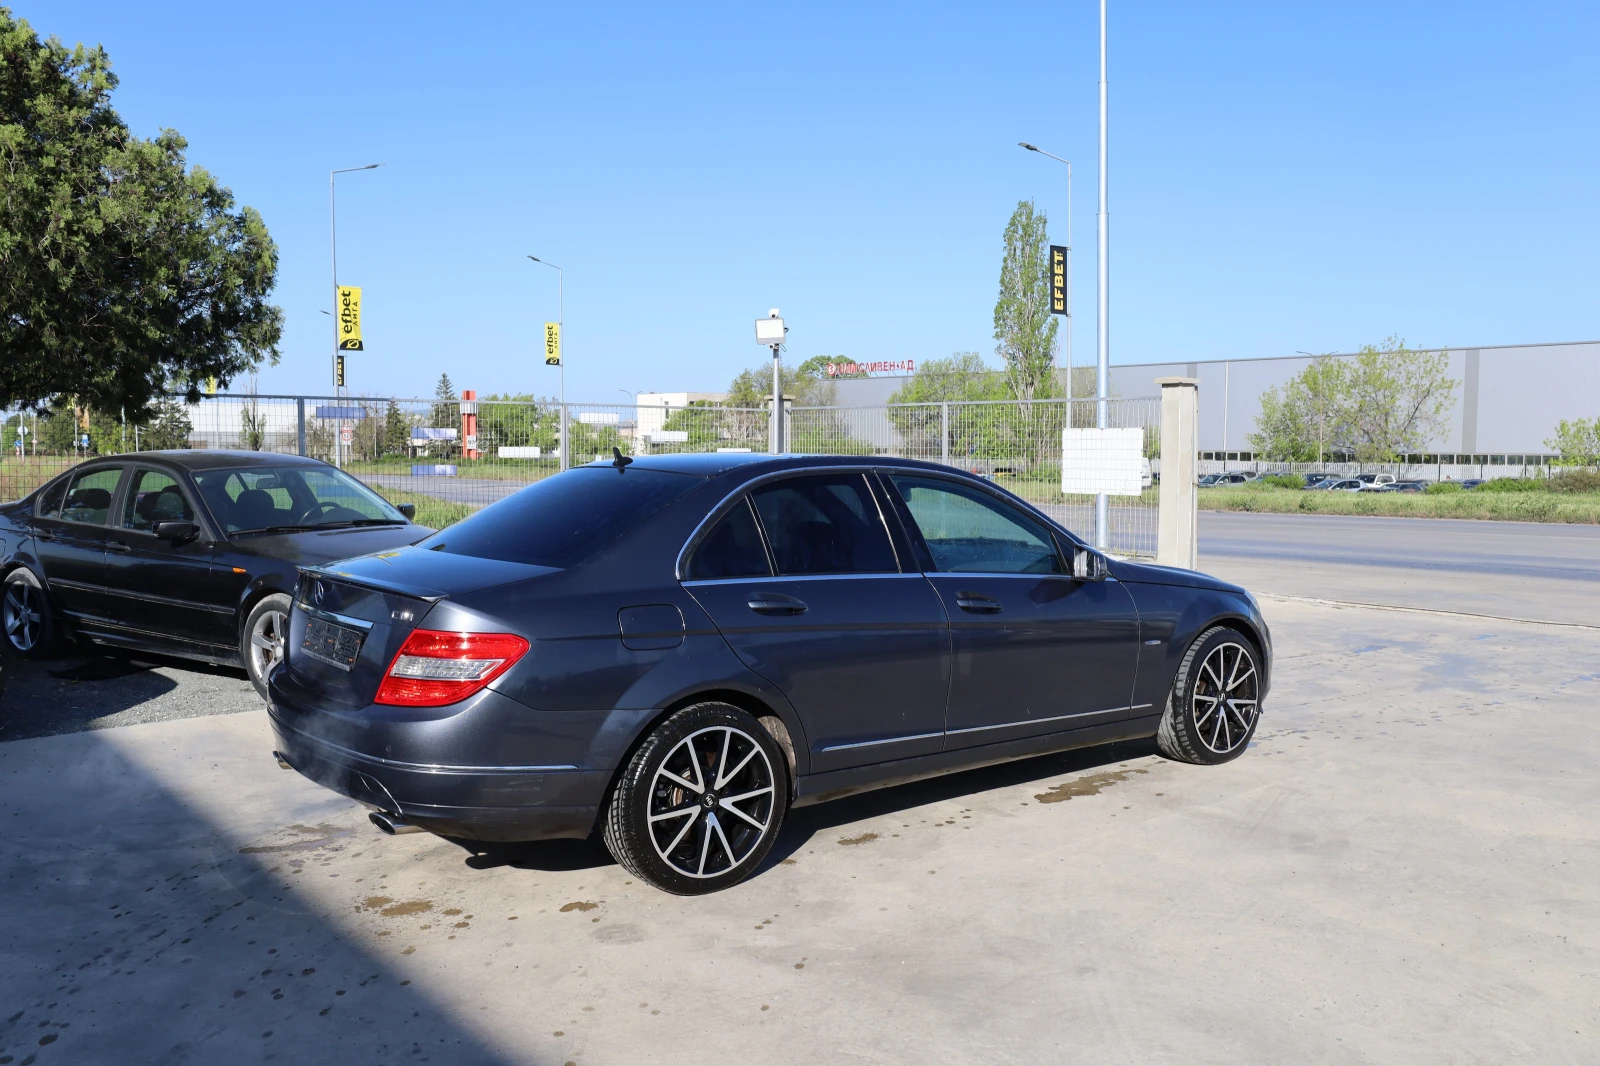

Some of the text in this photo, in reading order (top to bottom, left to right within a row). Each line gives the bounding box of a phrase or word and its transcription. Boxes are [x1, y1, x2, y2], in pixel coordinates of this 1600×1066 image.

[1054, 249, 1064, 311] EFBET
[341, 290, 353, 334] efbet
[546, 324, 554, 355] efbet
